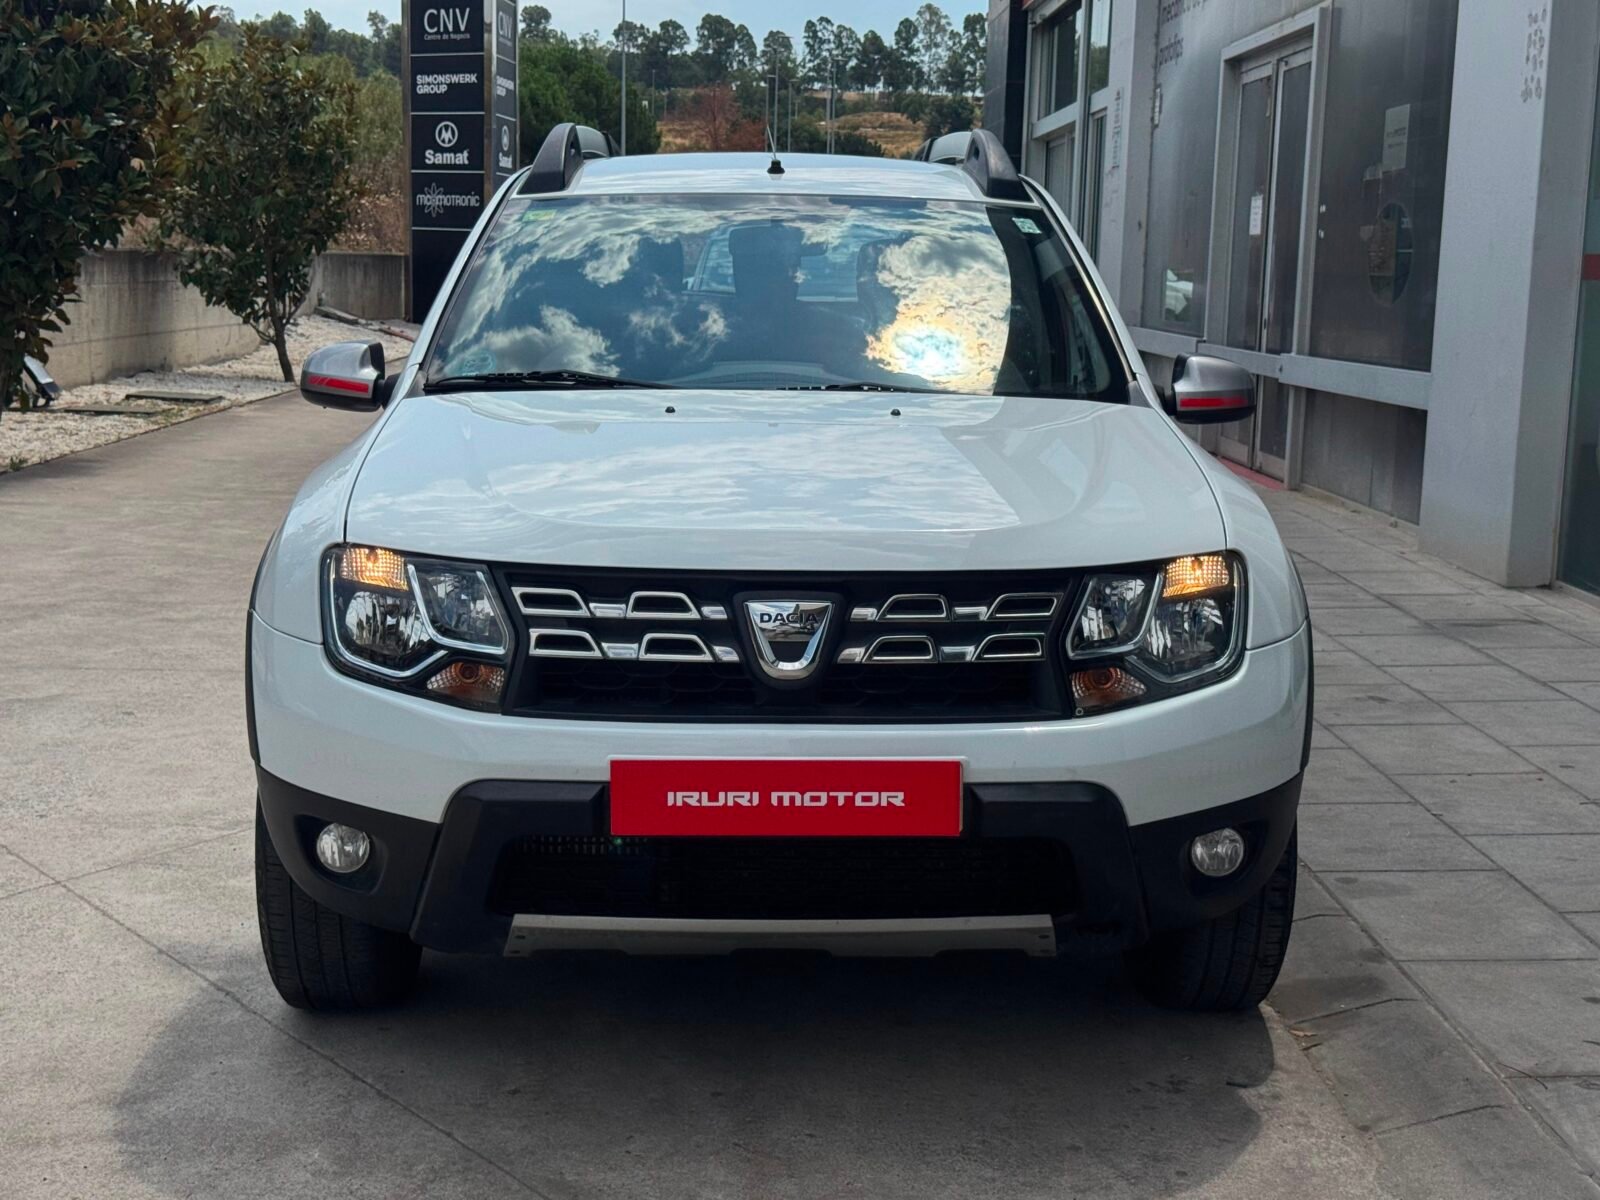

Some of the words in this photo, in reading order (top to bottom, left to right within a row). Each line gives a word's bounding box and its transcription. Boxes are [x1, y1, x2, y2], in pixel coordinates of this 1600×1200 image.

[424, 7, 470, 33] CNV
[416, 73, 478, 85] SIMONSWERK
[416, 84, 448, 94] GROUP
[425, 149, 469, 165] Samat
[760, 612, 818, 624] DACIA
[667, 791, 760, 807] IRURI
[770, 791, 906, 807] MOTOR
